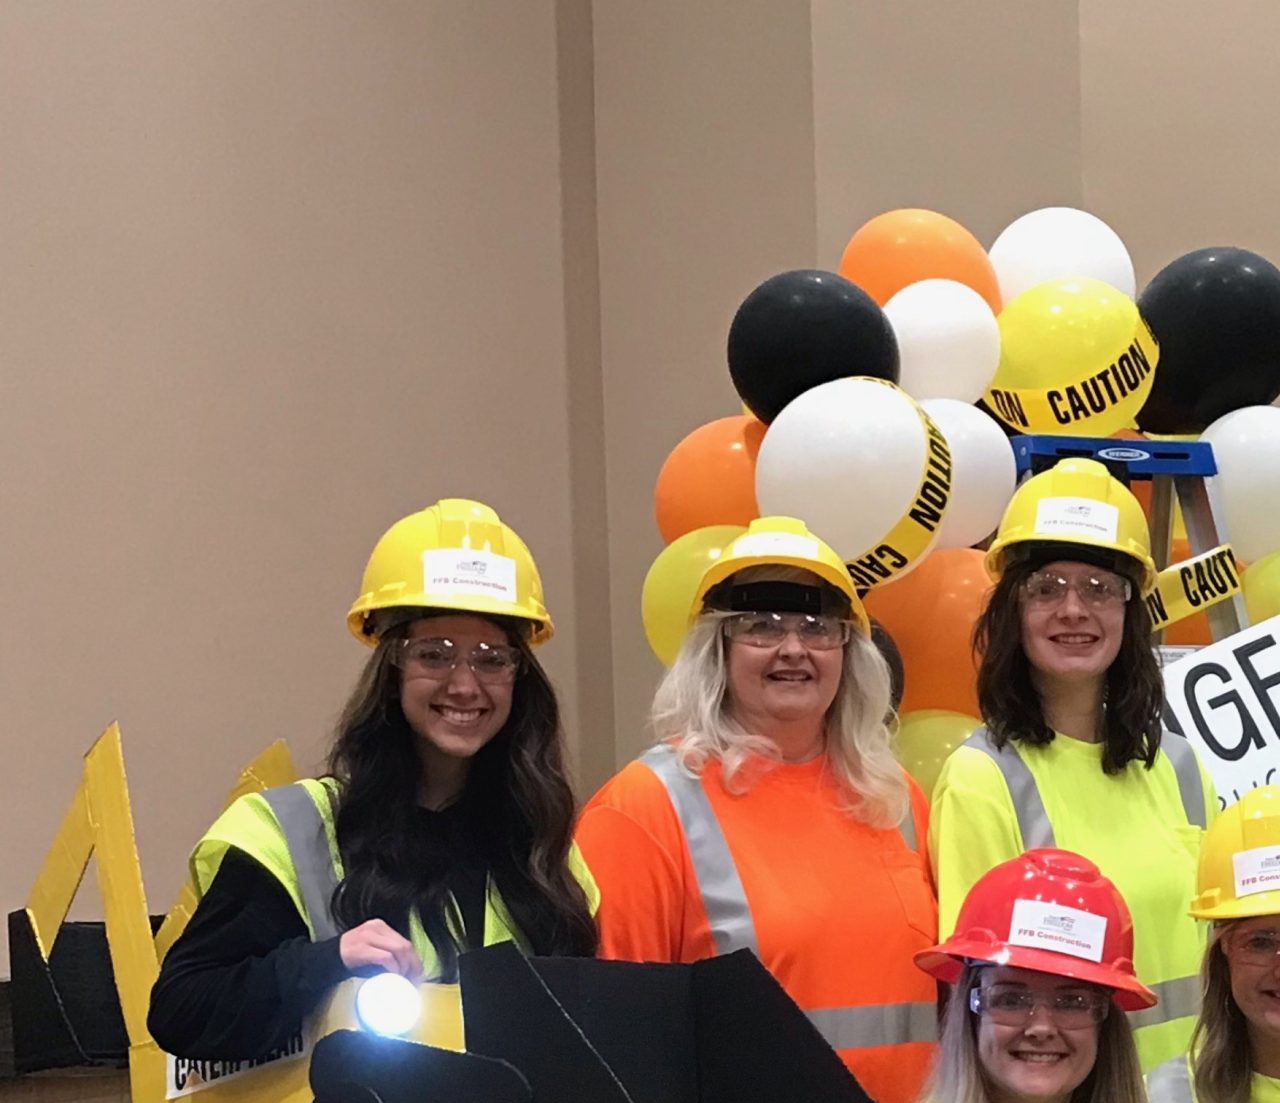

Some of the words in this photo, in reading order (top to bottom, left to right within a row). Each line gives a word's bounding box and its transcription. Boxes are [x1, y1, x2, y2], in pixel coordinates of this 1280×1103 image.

[1047, 338, 1151, 424] CAUTION
[1241, 877, 1258, 886] FFB
[1018, 928, 1035, 936] FFB
[1037, 931, 1092, 949] Construction
